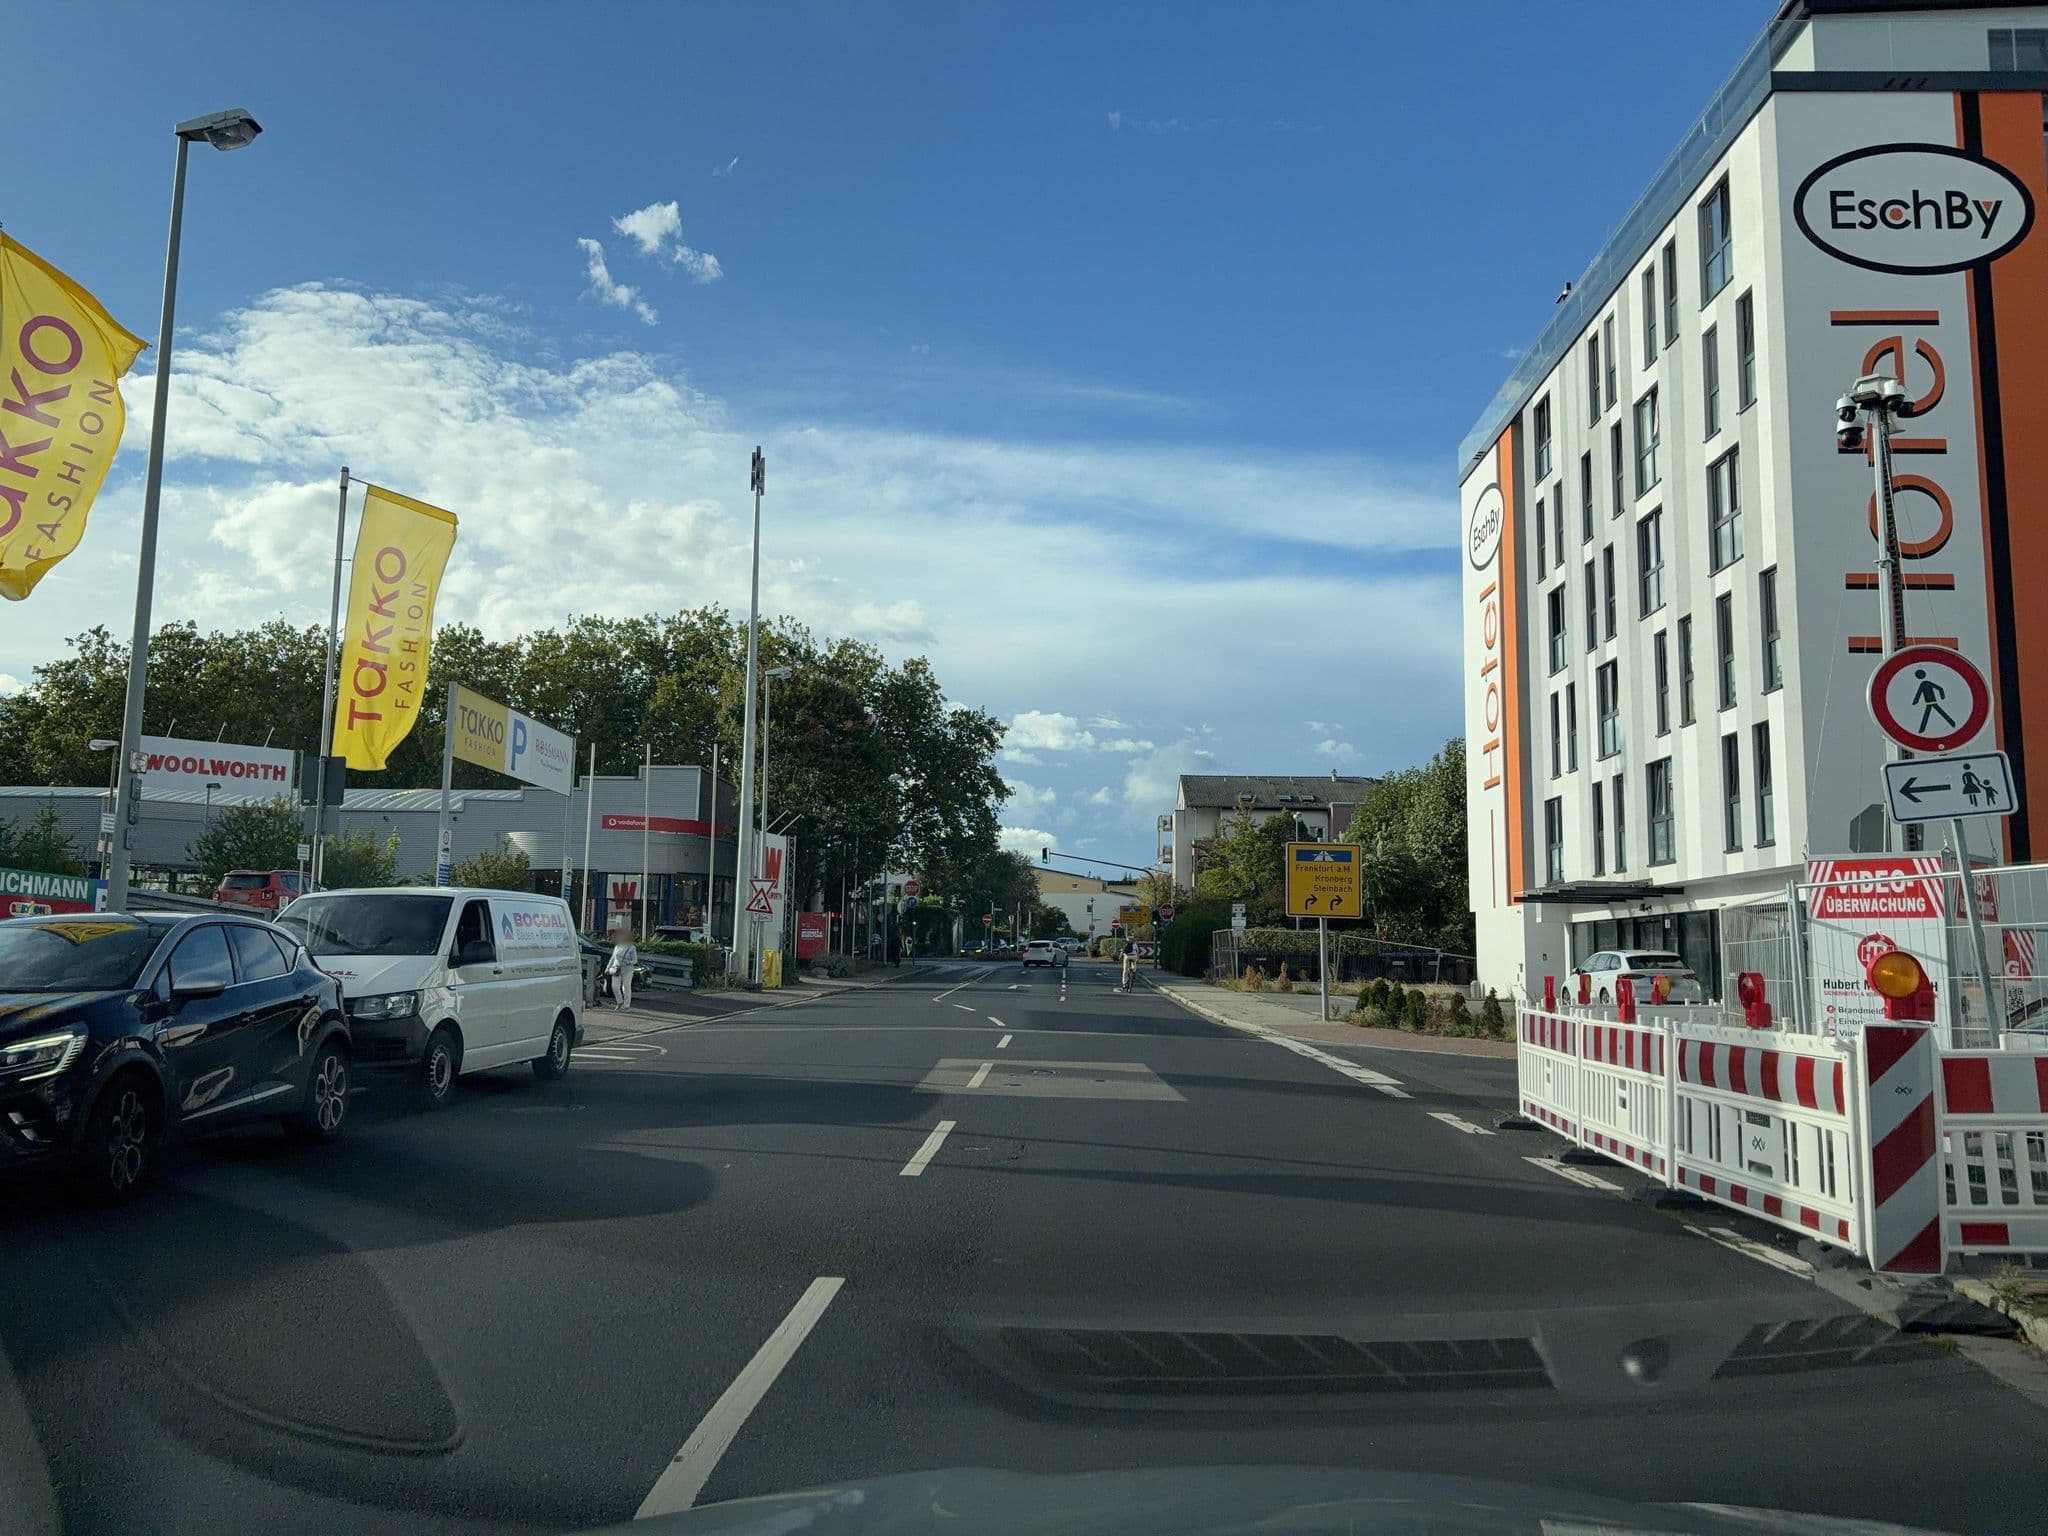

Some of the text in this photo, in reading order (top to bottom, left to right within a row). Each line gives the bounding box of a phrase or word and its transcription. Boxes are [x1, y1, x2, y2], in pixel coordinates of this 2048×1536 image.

[1830, 190, 2002, 239] EschBy
[24, 379, 115, 561] FASHION
[1473, 508, 1500, 552] EschBy
[394, 583, 428, 710] FASHION
[1479, 581, 1501, 791] Hotel
[464, 736, 497, 756] FASHION
[510, 718, 528, 771] P
[535, 738, 569, 765] ROSSMANN
[147, 753, 287, 782] WOOLWORTH
[1295, 864, 1334, 873] Frankfurt
[1314, 875, 1353, 885] Kronberg
[1313, 884, 1353, 893] Steinbach
[1834, 869, 1915, 894] VIDEO-
[1160, 908, 1174, 917] STOP
[1826, 895, 1927, 914] ÜBERWACHUNG
[1823, 979, 1860, 991] Hubert
[1838, 1006, 1885, 1016] Brandmeld
